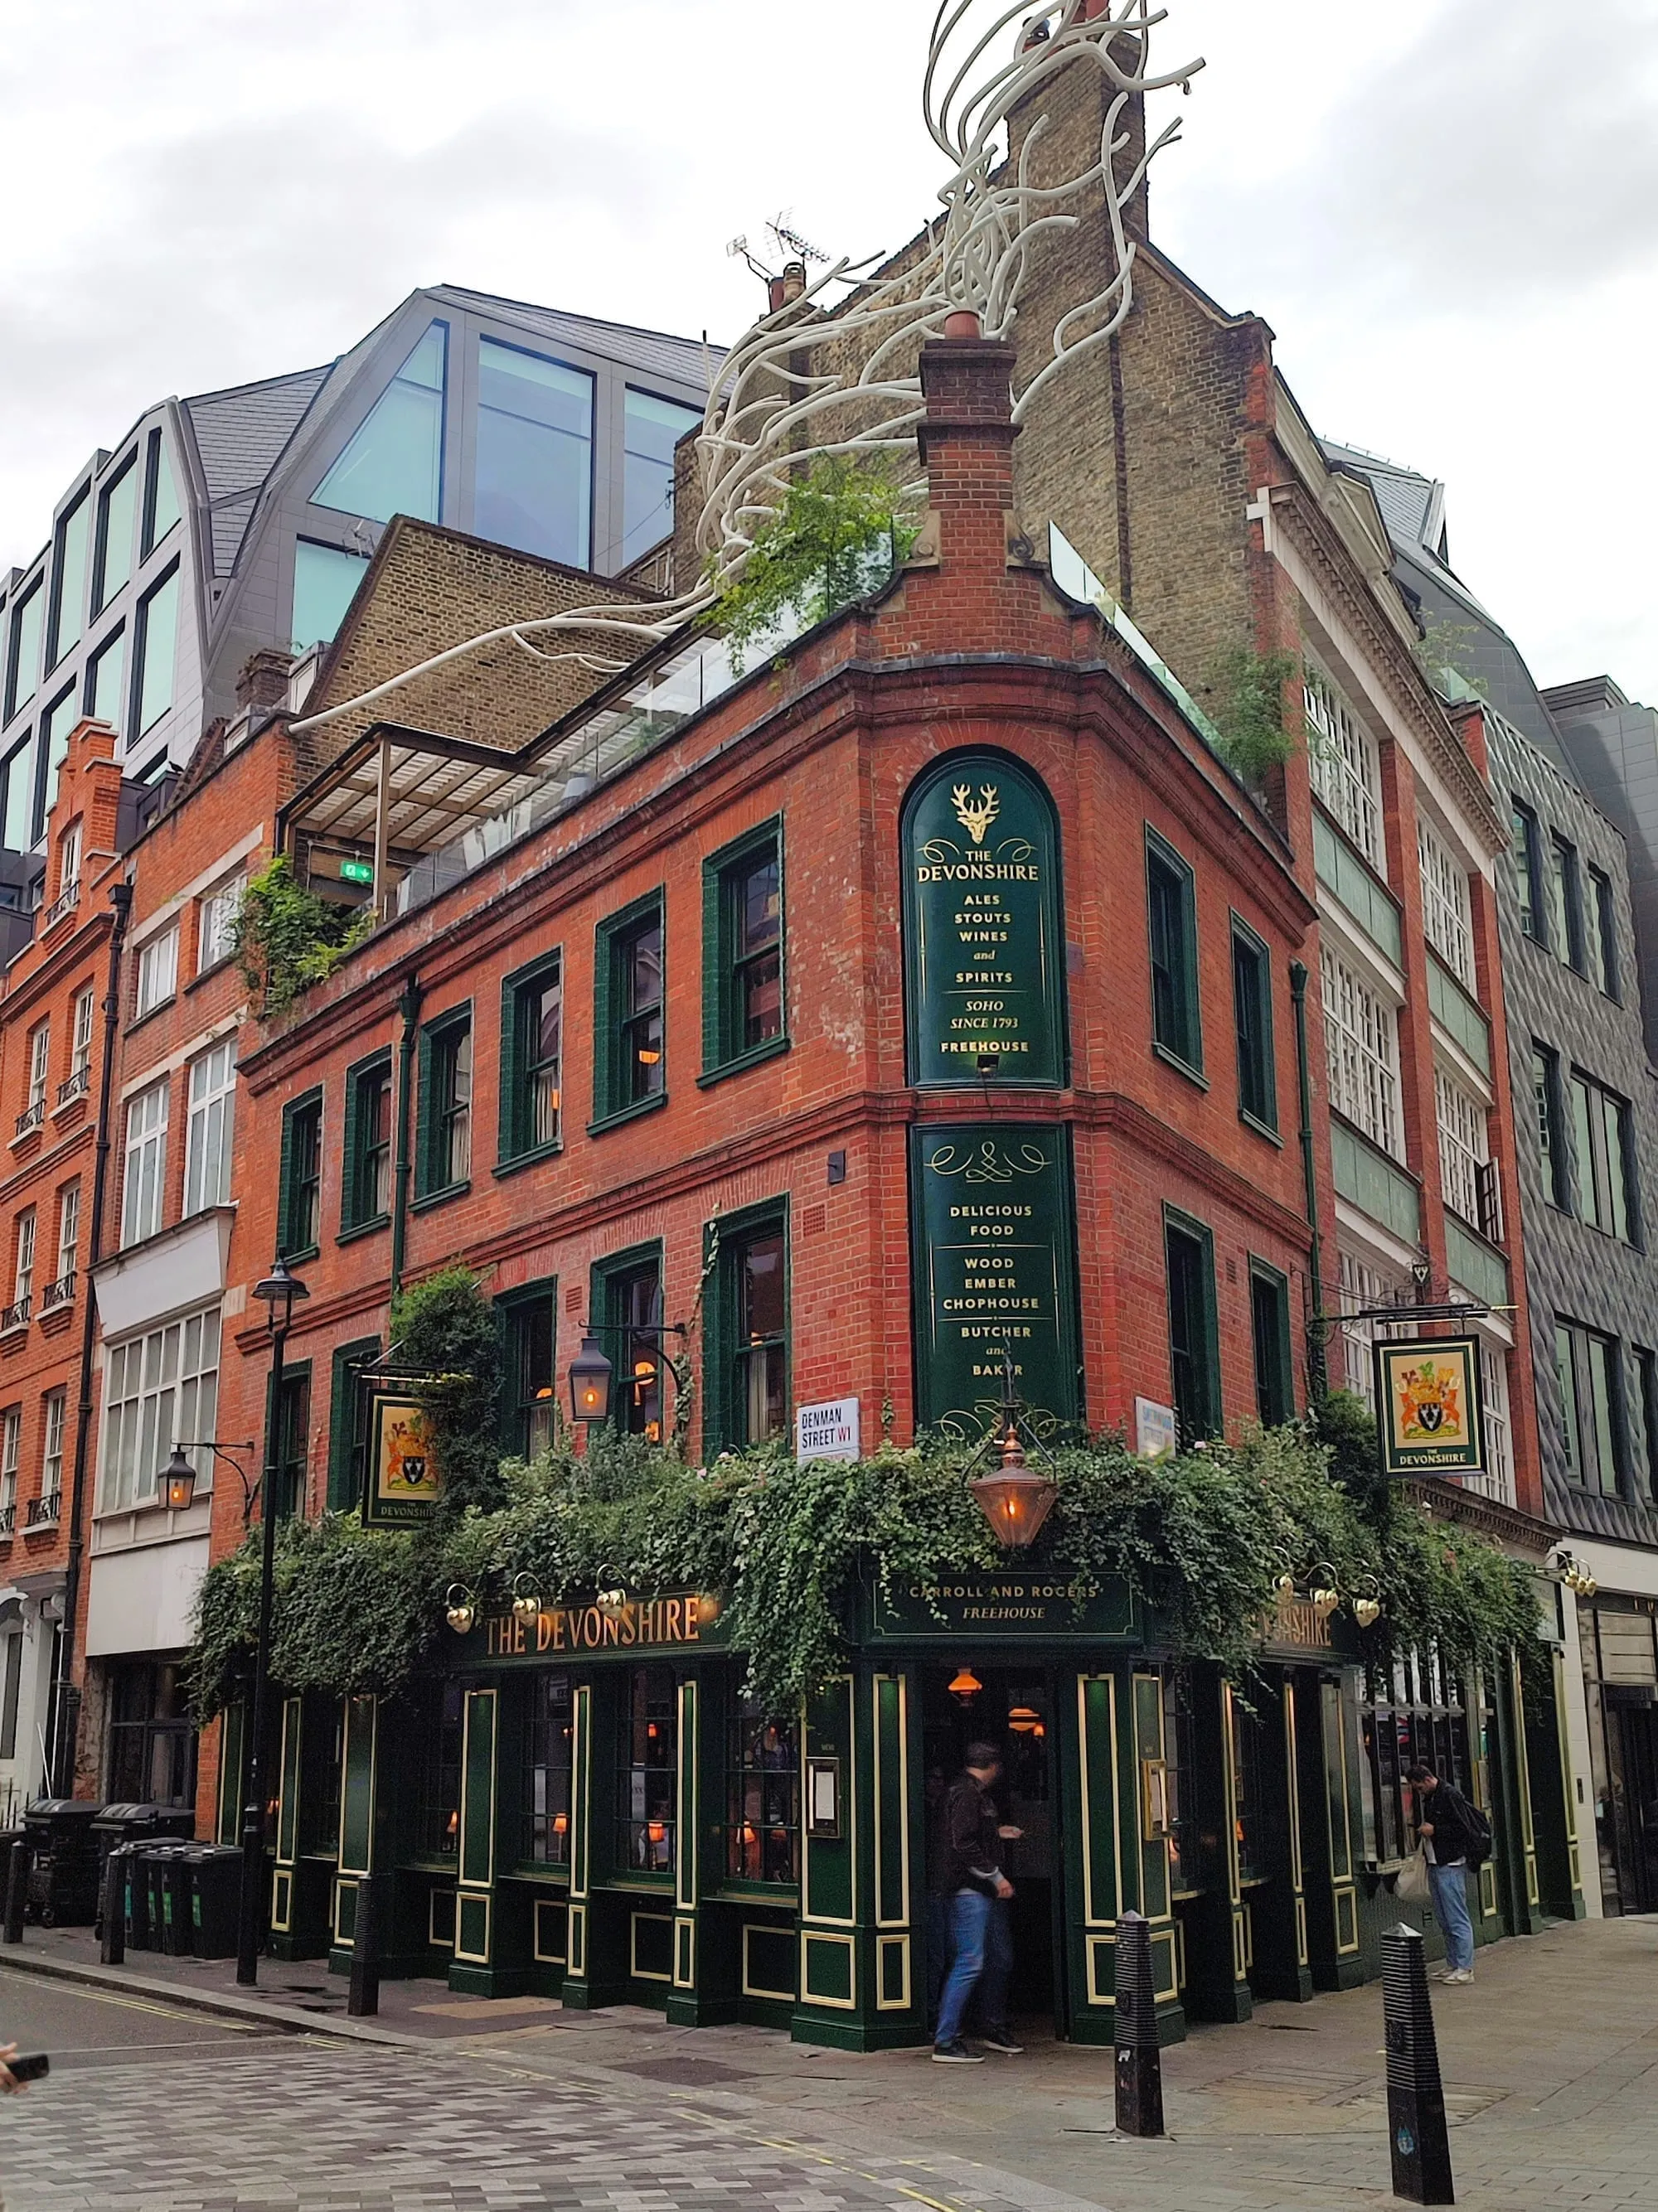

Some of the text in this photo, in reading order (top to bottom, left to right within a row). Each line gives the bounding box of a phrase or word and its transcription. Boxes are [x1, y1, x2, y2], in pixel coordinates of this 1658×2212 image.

[965, 850, 991, 862] THE
[918, 864, 1039, 883] DEVONSHIRE
[964, 895, 1000, 906] ALES
[954, 912, 1011, 924] STOUTS
[959, 932, 1008, 941] WINES
[973, 951, 995, 961] and
[956, 972, 1013, 983] SPIRITS
[966, 1000, 1004, 1012] SOHO
[950, 1017, 1019, 1029] SINCE 1793
[941, 1042, 1029, 1053] FREEHOUSE
[950, 1206, 1033, 1217] DELICIOUS
[970, 1225, 1014, 1237] FOOD
[965, 1258, 1014, 1269] WOOD
[965, 1278, 1016, 1290] EMBER
[943, 1298, 1040, 1310] CHOPHOUSE
[961, 1327, 1031, 1338] BUTCHER
[973, 1365, 1023, 1376] BAKR
[802, 1407, 841, 1429] DENMAN
[802, 1425, 851, 1449] STREET W1
[1399, 1453, 1466, 1465] DEVONSHIRE
[909, 1586, 984, 1598] CARROLL
[991, 1585, 1024, 1598] AND
[962, 1607, 1045, 1619] FREEHOUSE
[487, 1597, 700, 1655] THE DEVONSHIRE
